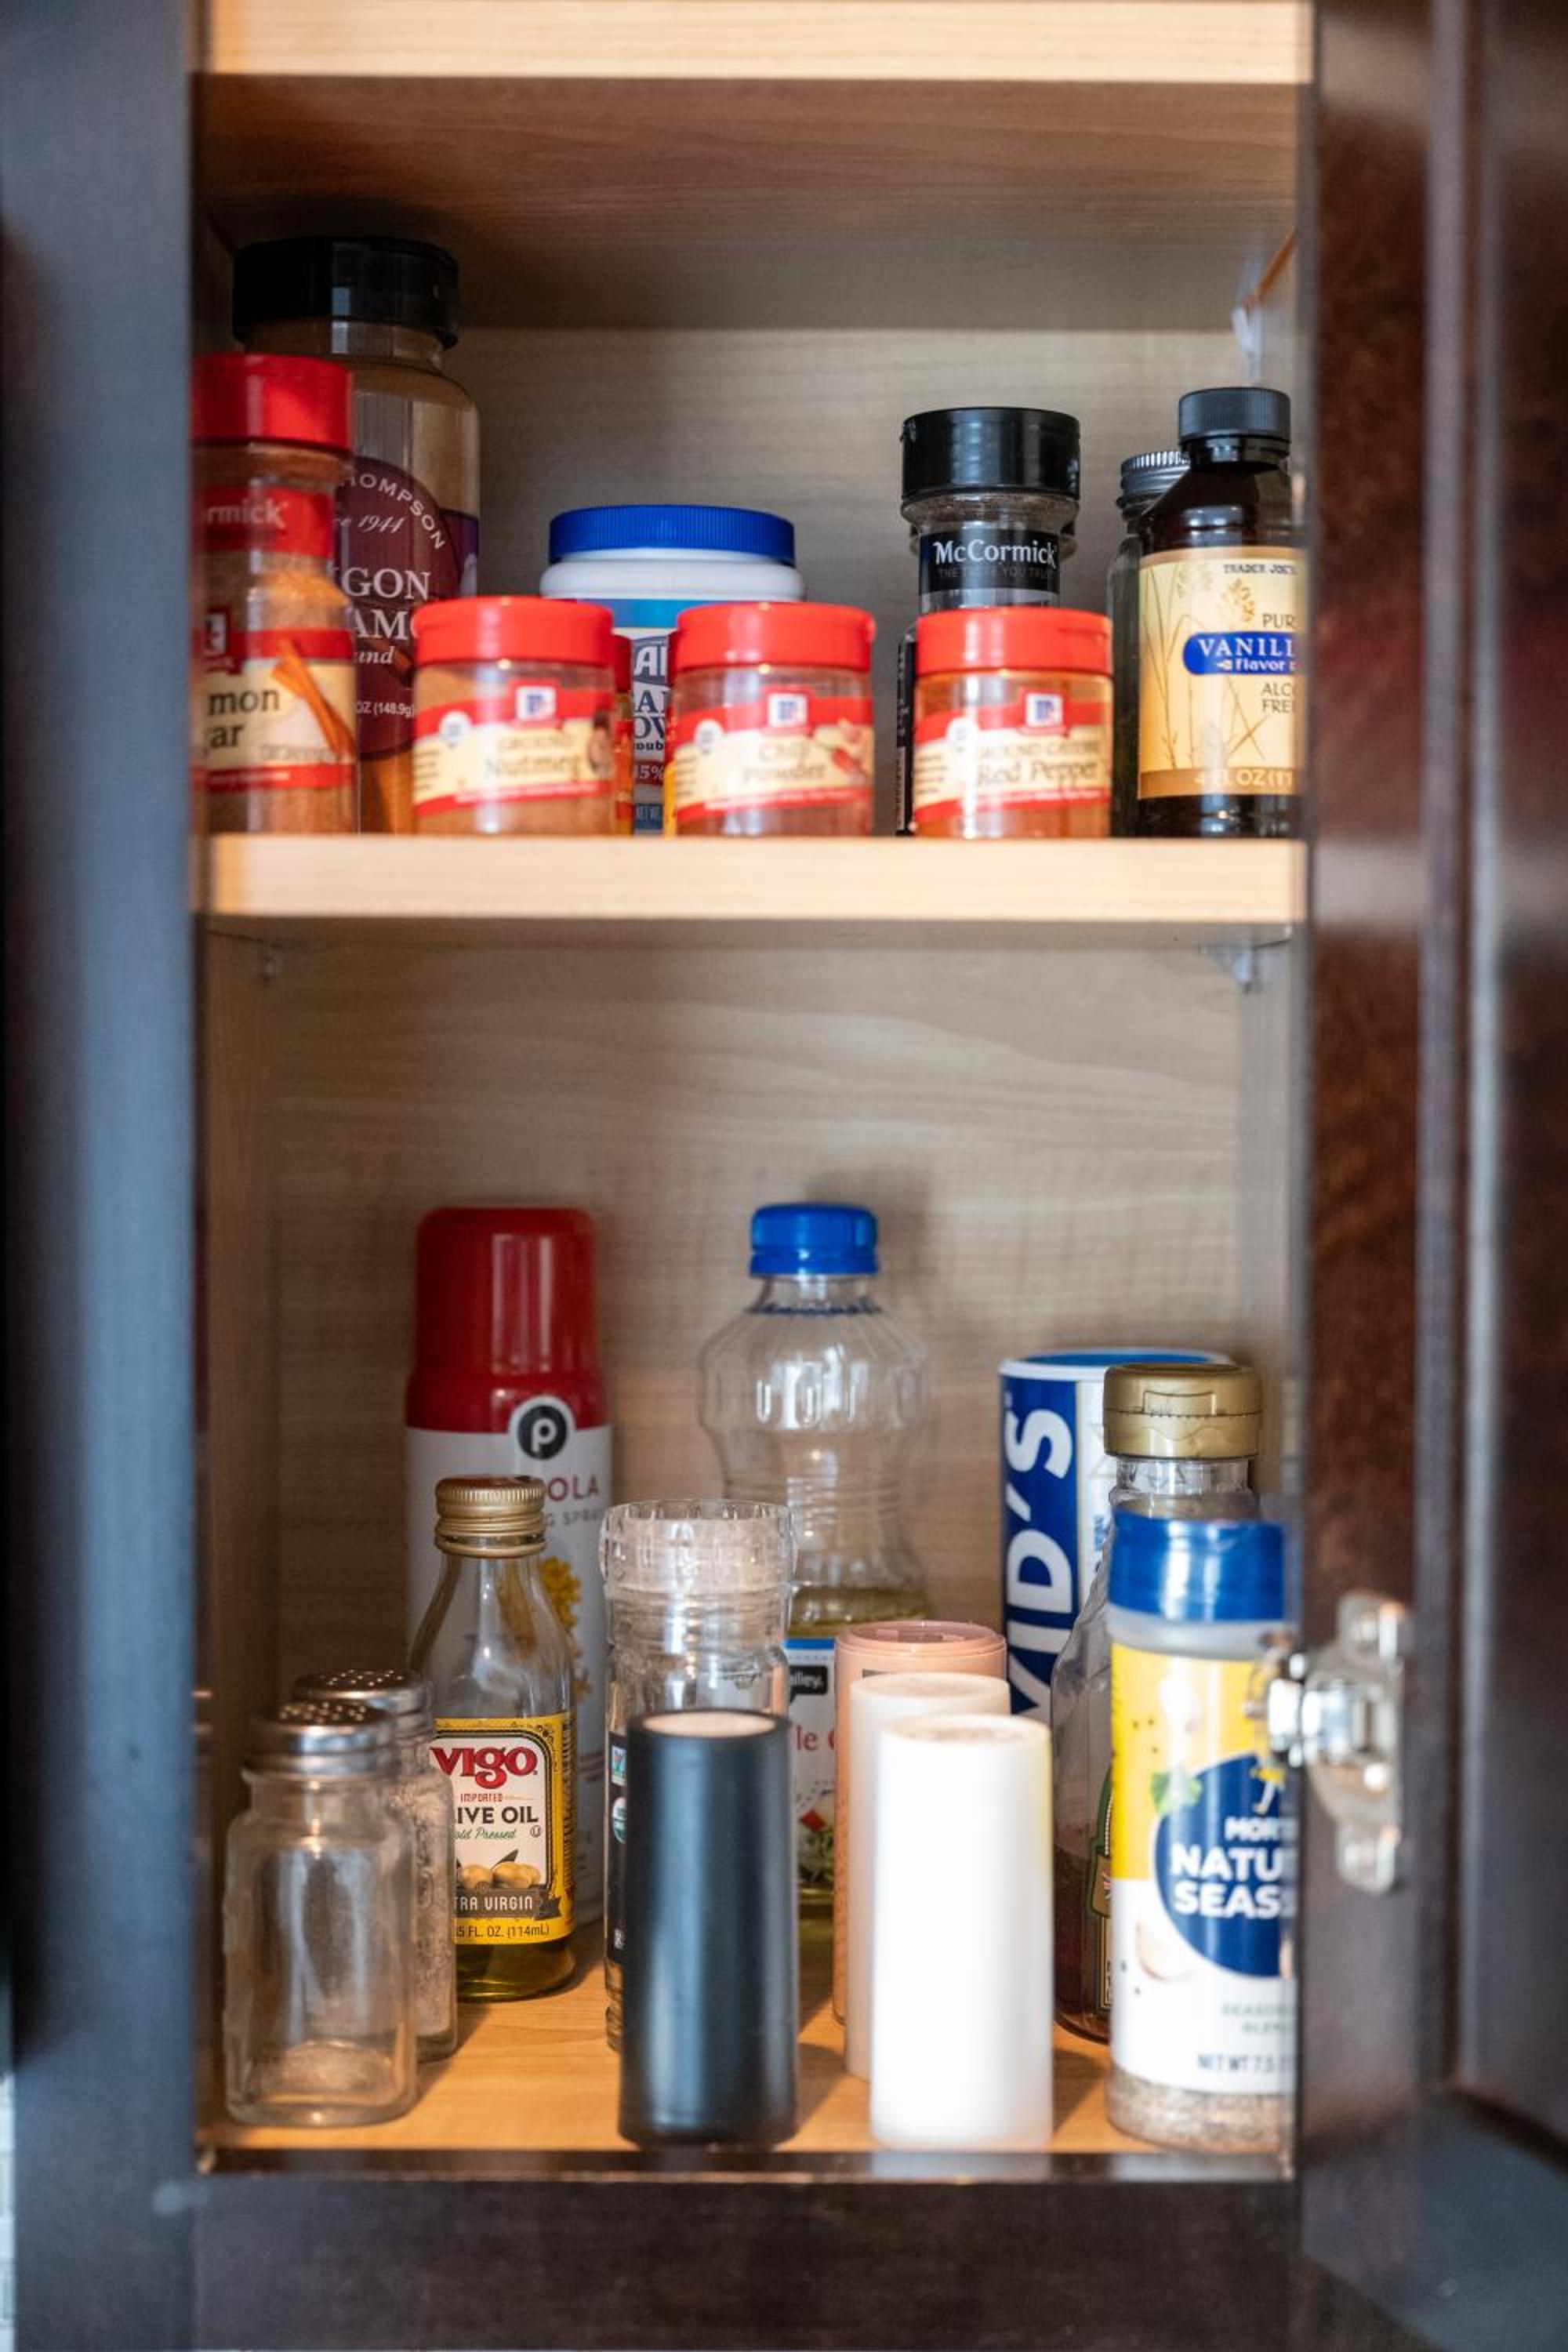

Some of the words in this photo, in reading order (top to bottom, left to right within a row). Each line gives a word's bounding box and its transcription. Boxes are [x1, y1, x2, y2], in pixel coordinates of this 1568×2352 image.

[207, 499, 287, 528] rmick
[343, 473, 445, 550] HOMPSON
[932, 539, 1057, 569] McCormick
[341, 566, 432, 602] GON
[1262, 613, 1294, 629] PUR
[354, 646, 394, 665] und
[207, 688, 281, 716] mon
[1262, 699, 1295, 713] FRE
[209, 723, 245, 749] ar
[546, 1474, 599, 1502] OLA
[455, 1806, 495, 1824] IVE
[501, 1806, 539, 1824] OIL
[454, 1828, 471, 1840] old
[484, 1896, 533, 1911] VIRGIN
